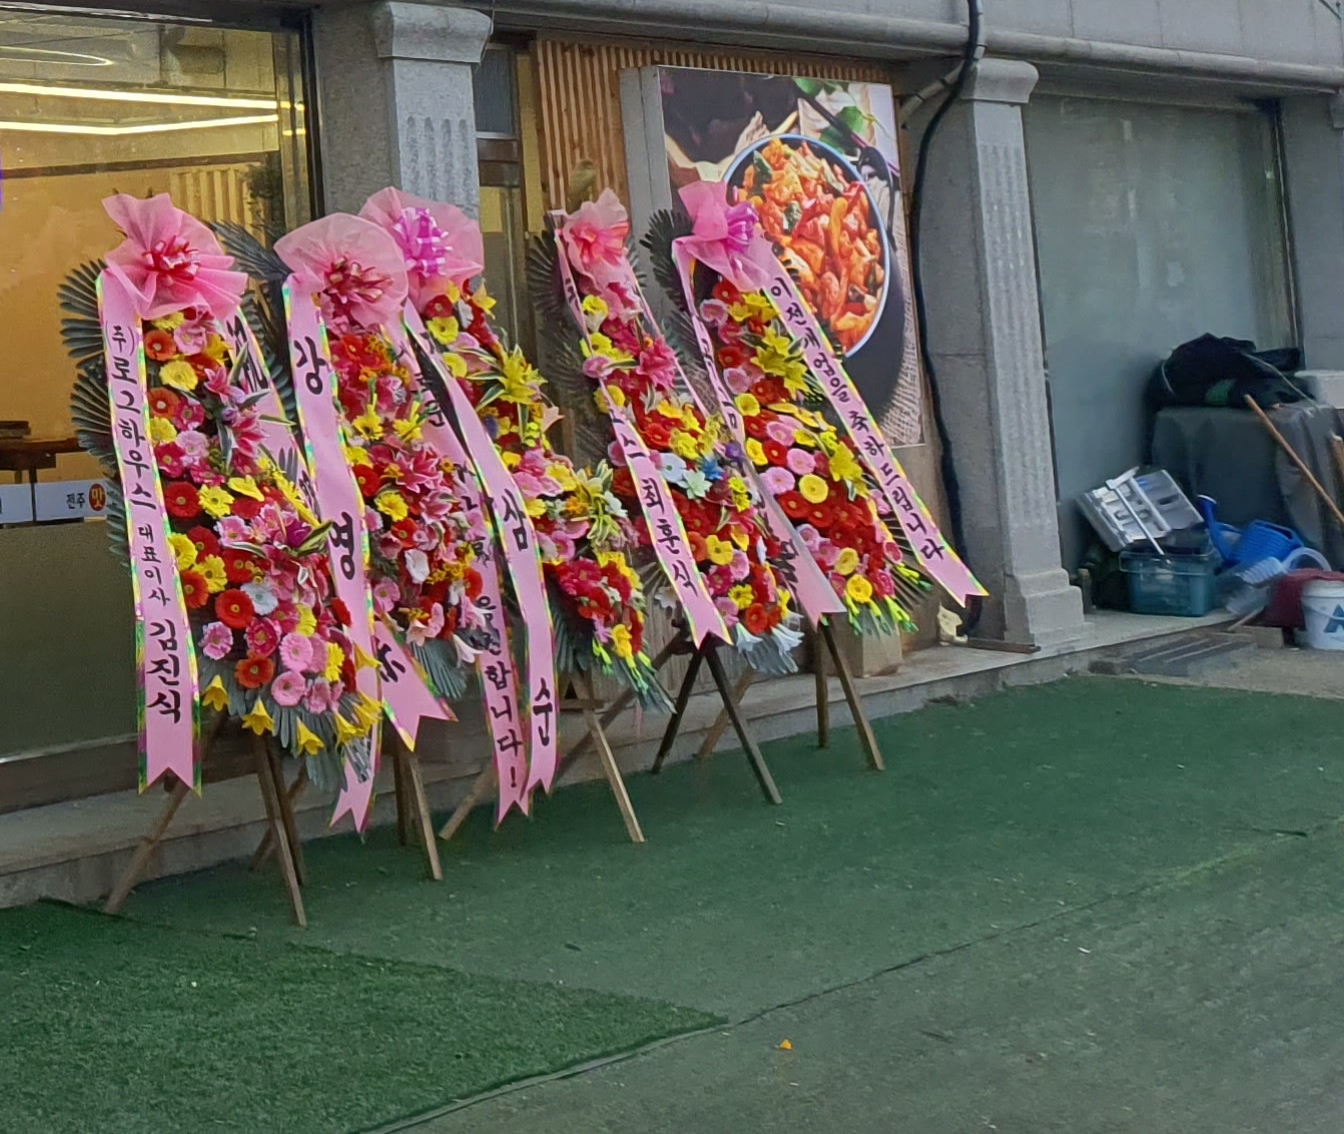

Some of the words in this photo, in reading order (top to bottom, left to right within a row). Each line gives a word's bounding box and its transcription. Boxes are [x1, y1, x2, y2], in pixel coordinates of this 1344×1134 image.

[65, 492, 87, 511] 전주
[92, 484, 108, 511] 맛
[849, 410, 946, 561] 축하드립니다
[138, 523, 171, 607] 대표이사
[146, 619, 181, 724] 김진식
